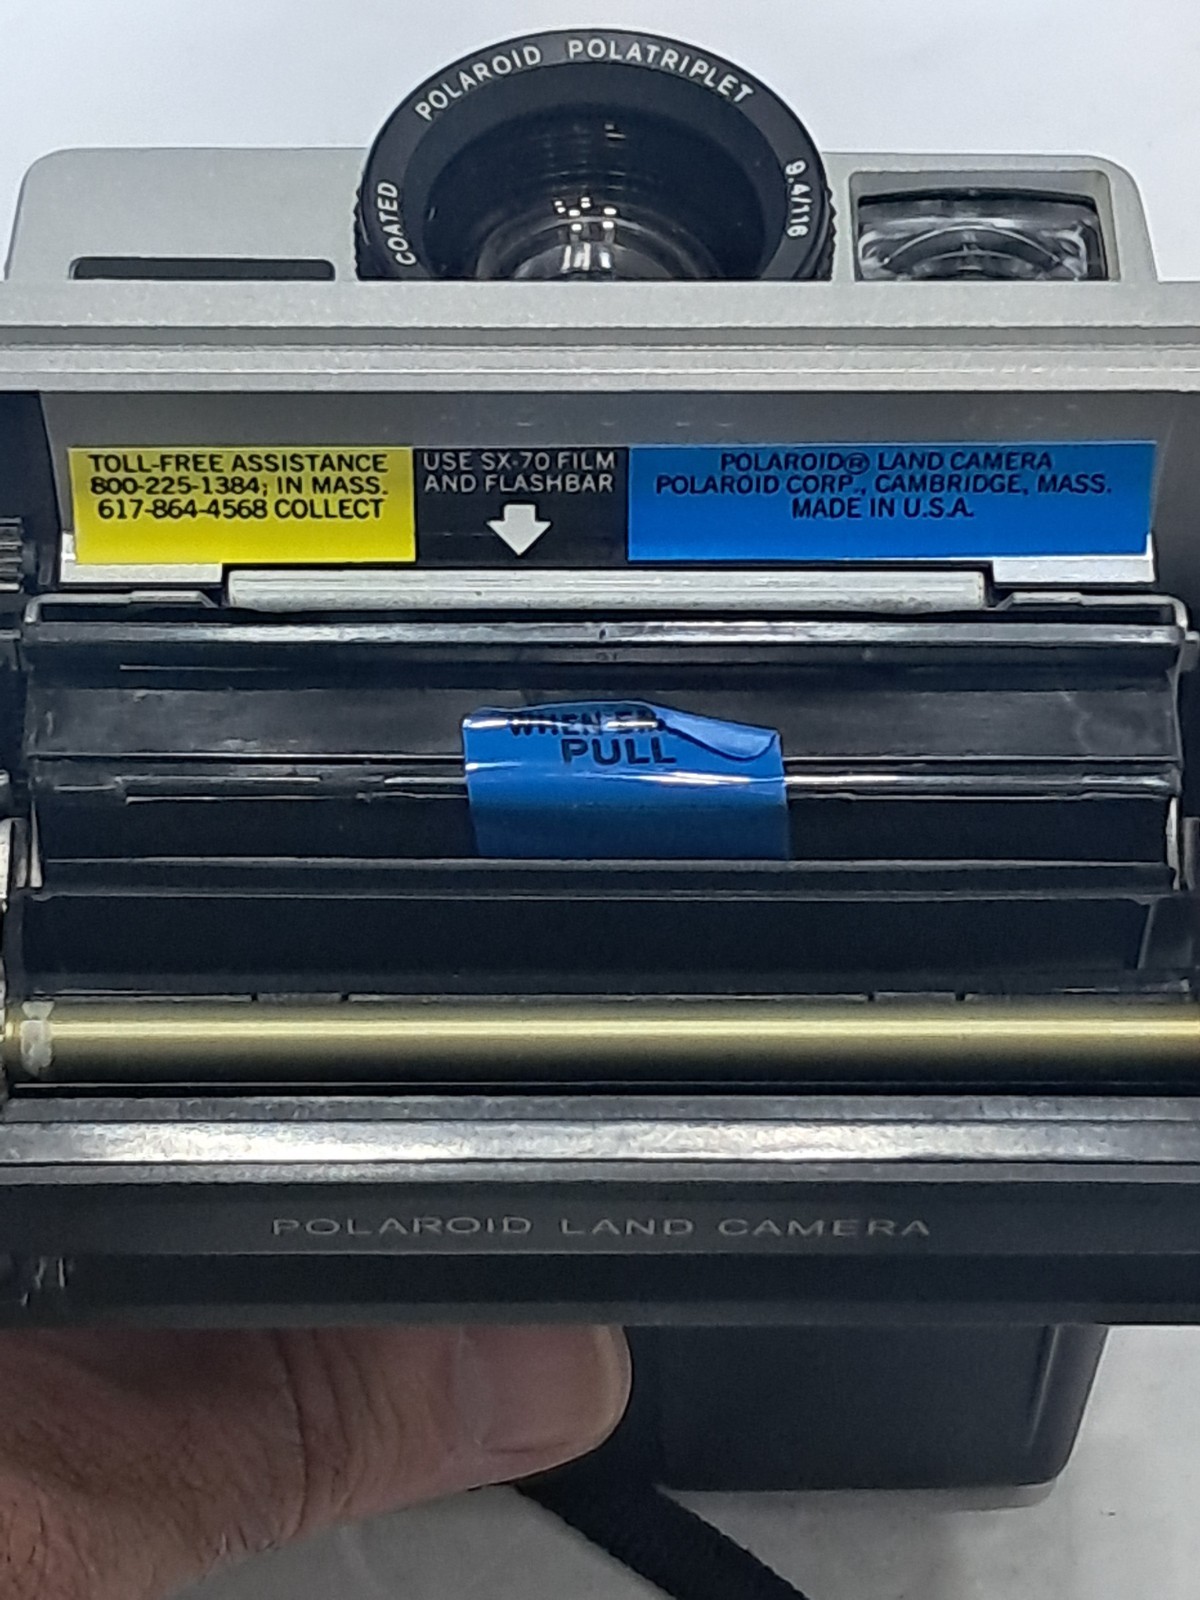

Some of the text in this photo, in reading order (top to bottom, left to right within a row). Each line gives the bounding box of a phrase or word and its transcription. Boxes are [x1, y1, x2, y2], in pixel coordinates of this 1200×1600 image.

[415, 39, 756, 121] POLAROID POLATRIPLET
[784, 160, 812, 238] 9.4/116
[376, 181, 417, 266] COATED
[88, 453, 389, 472] TOLL-FREE ASSISTANCE
[423, 451, 615, 470] USE SX-70 FILM
[878, 452, 944, 471] LAND
[951, 451, 1053, 471] CAMERA
[90, 476, 389, 497] 800-225-1384; IN MASS.
[424, 474, 614, 493] AND FLASHBAR
[656, 474, 780, 494] POLAROID
[875, 474, 1029, 496] CAMBRIDGE,
[1037, 473, 1112, 494] MASS.
[98, 498, 385, 519] 617-864-4568 COLLECT
[792, 497, 975, 519] MADE IN U.S.A.
[561, 737, 678, 765] PULL
[273, 1216, 930, 1236] POLAROID LAND CAMERA
